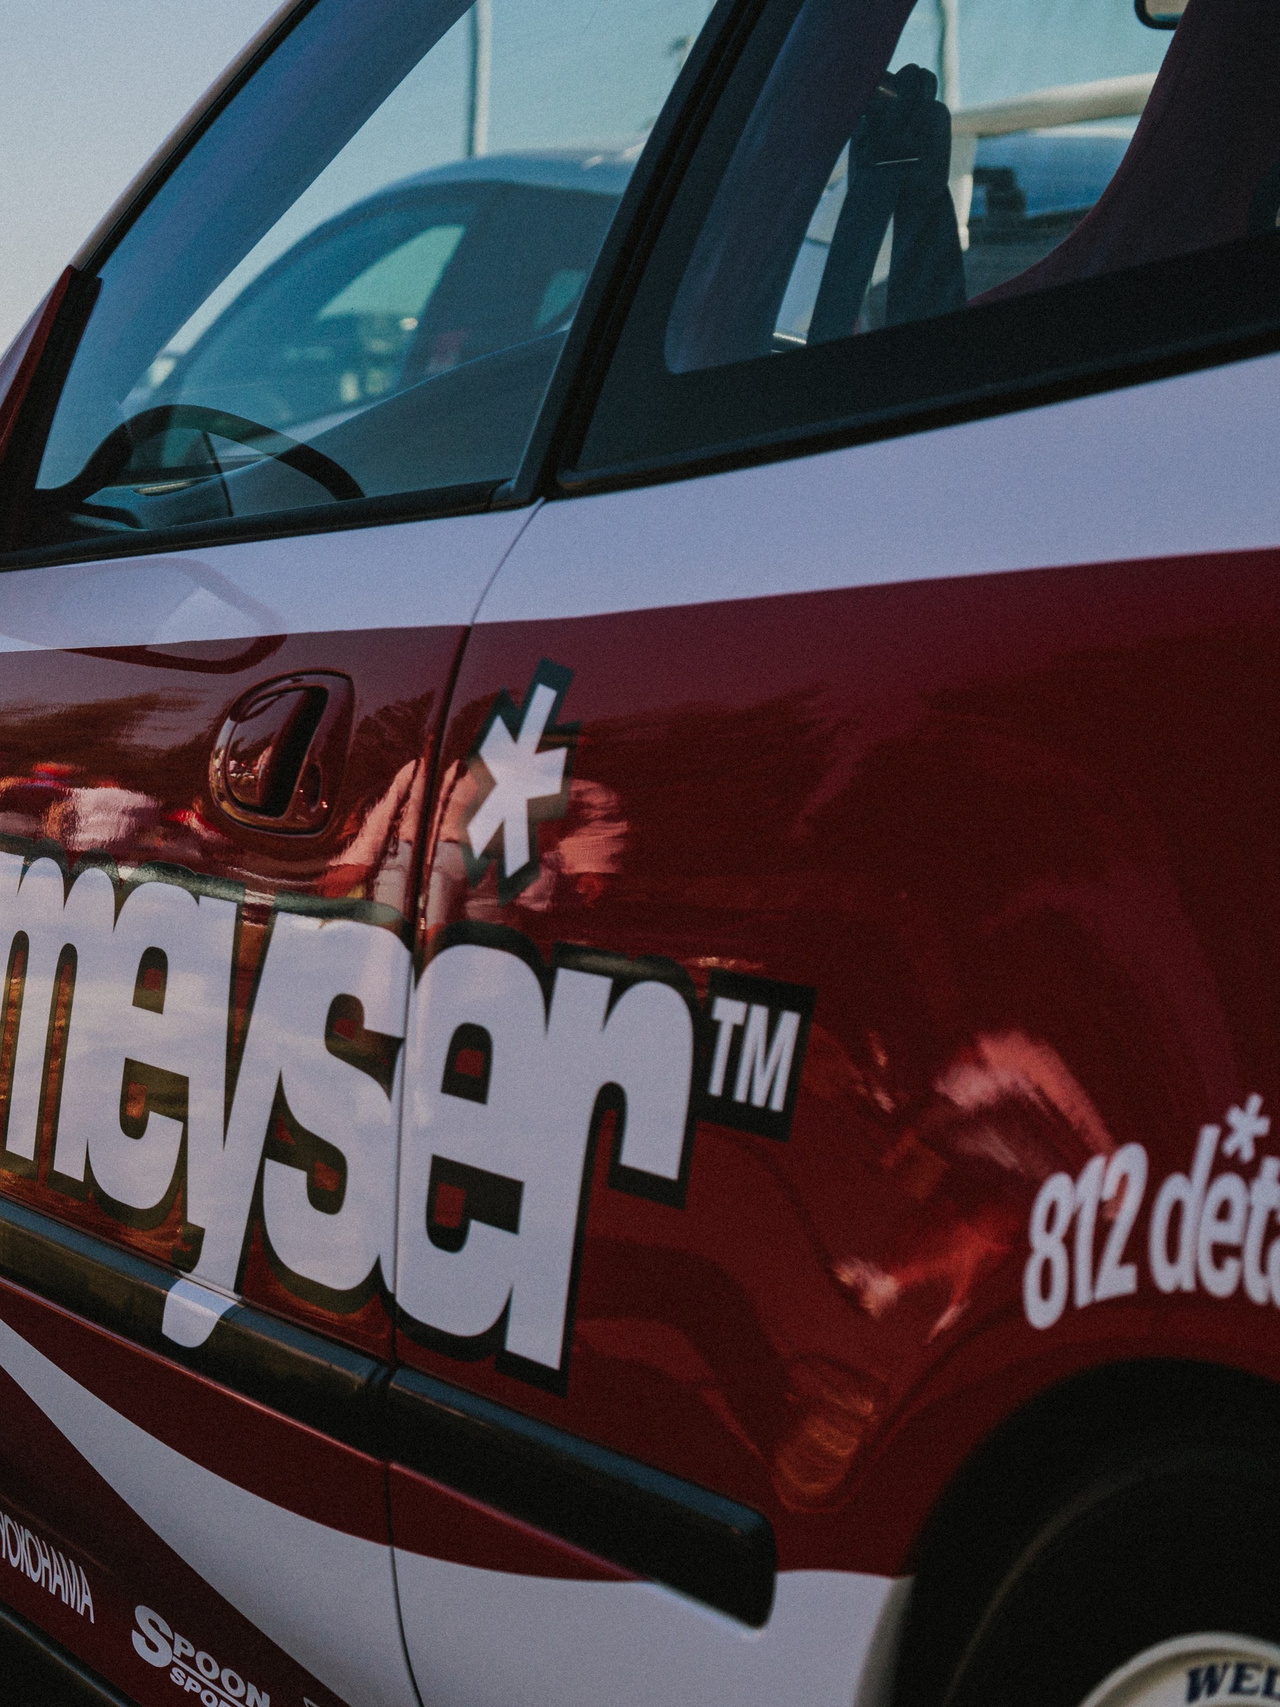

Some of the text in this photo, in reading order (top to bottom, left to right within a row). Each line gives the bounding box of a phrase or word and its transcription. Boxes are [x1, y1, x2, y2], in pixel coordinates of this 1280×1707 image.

[1023, 1142, 1148, 1331] 812
[131, 1604, 271, 1707] SPOON
[169, 1666, 228, 1707] SPO
